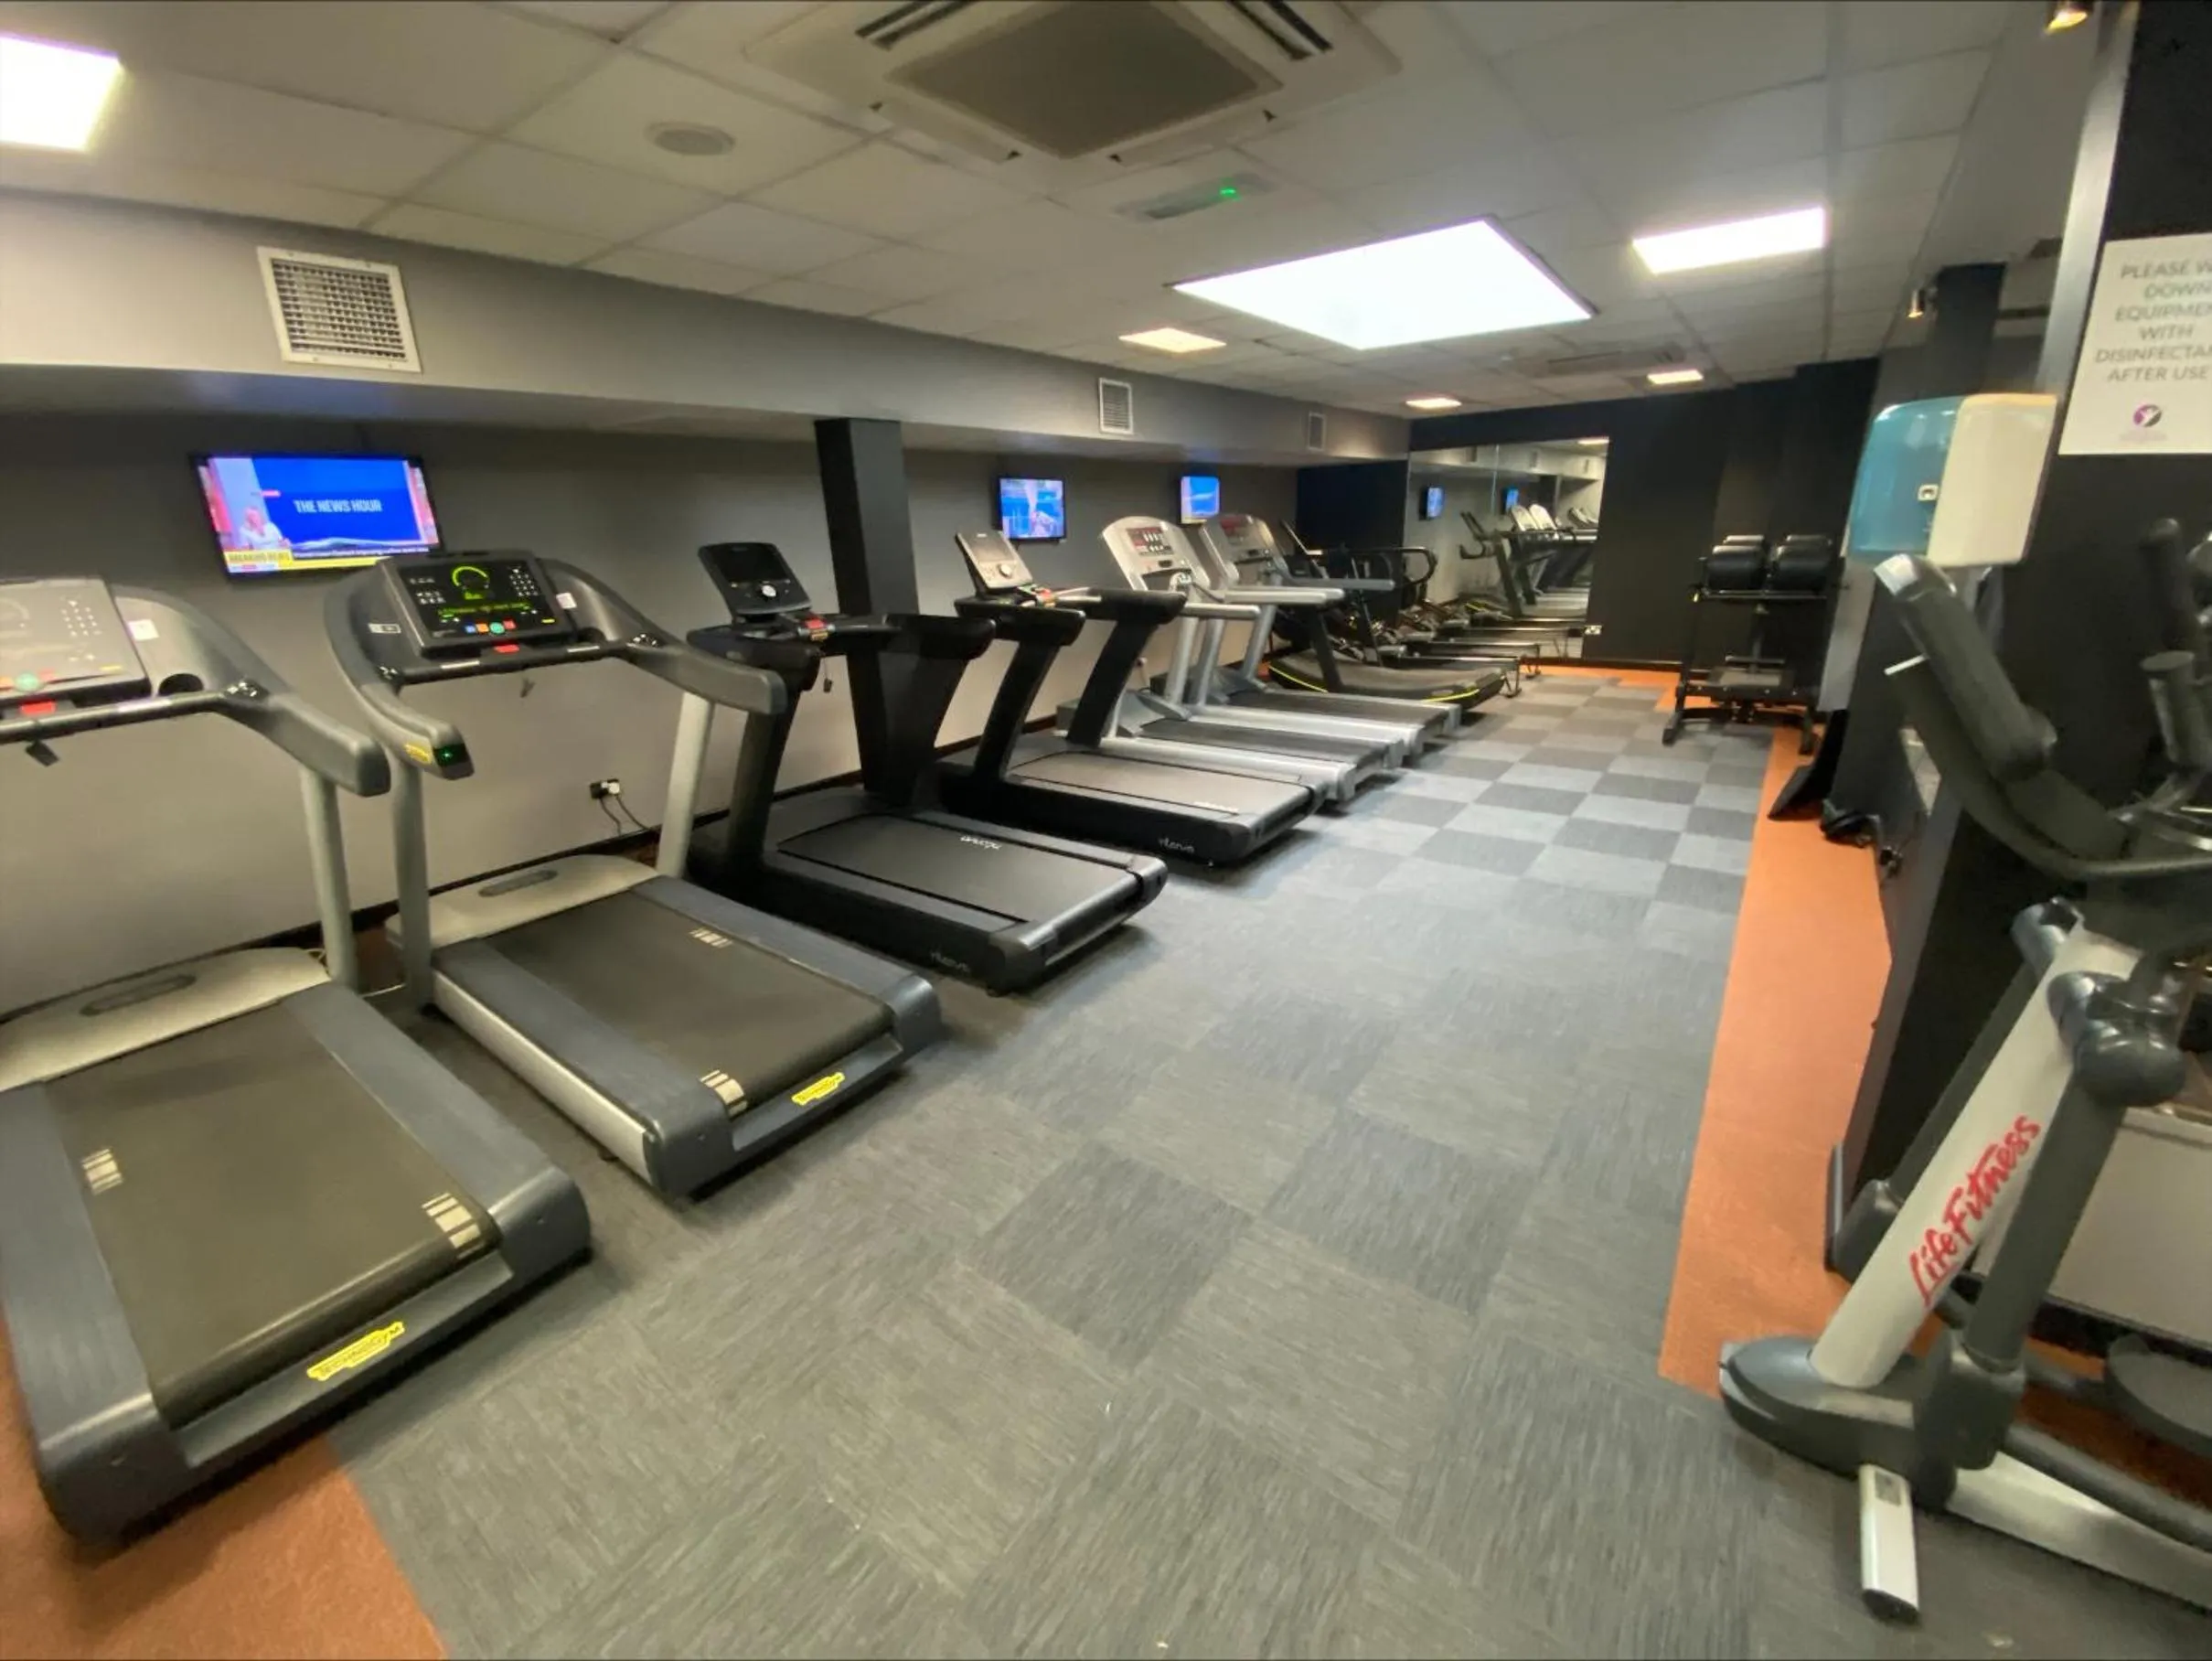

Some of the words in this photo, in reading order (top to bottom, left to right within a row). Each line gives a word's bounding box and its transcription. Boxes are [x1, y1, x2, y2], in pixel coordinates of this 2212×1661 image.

[2120, 260, 2189, 279] PLEASE
[2140, 324, 2194, 340] WITH
[2096, 344, 2212, 363] DISINFECTA
[2108, 367, 2168, 382] AFTER
[2174, 366, 2209, 380] USE
[293, 499, 317, 514] THE
[317, 499, 351, 512] NEWS
[351, 499, 382, 512] HOUR
